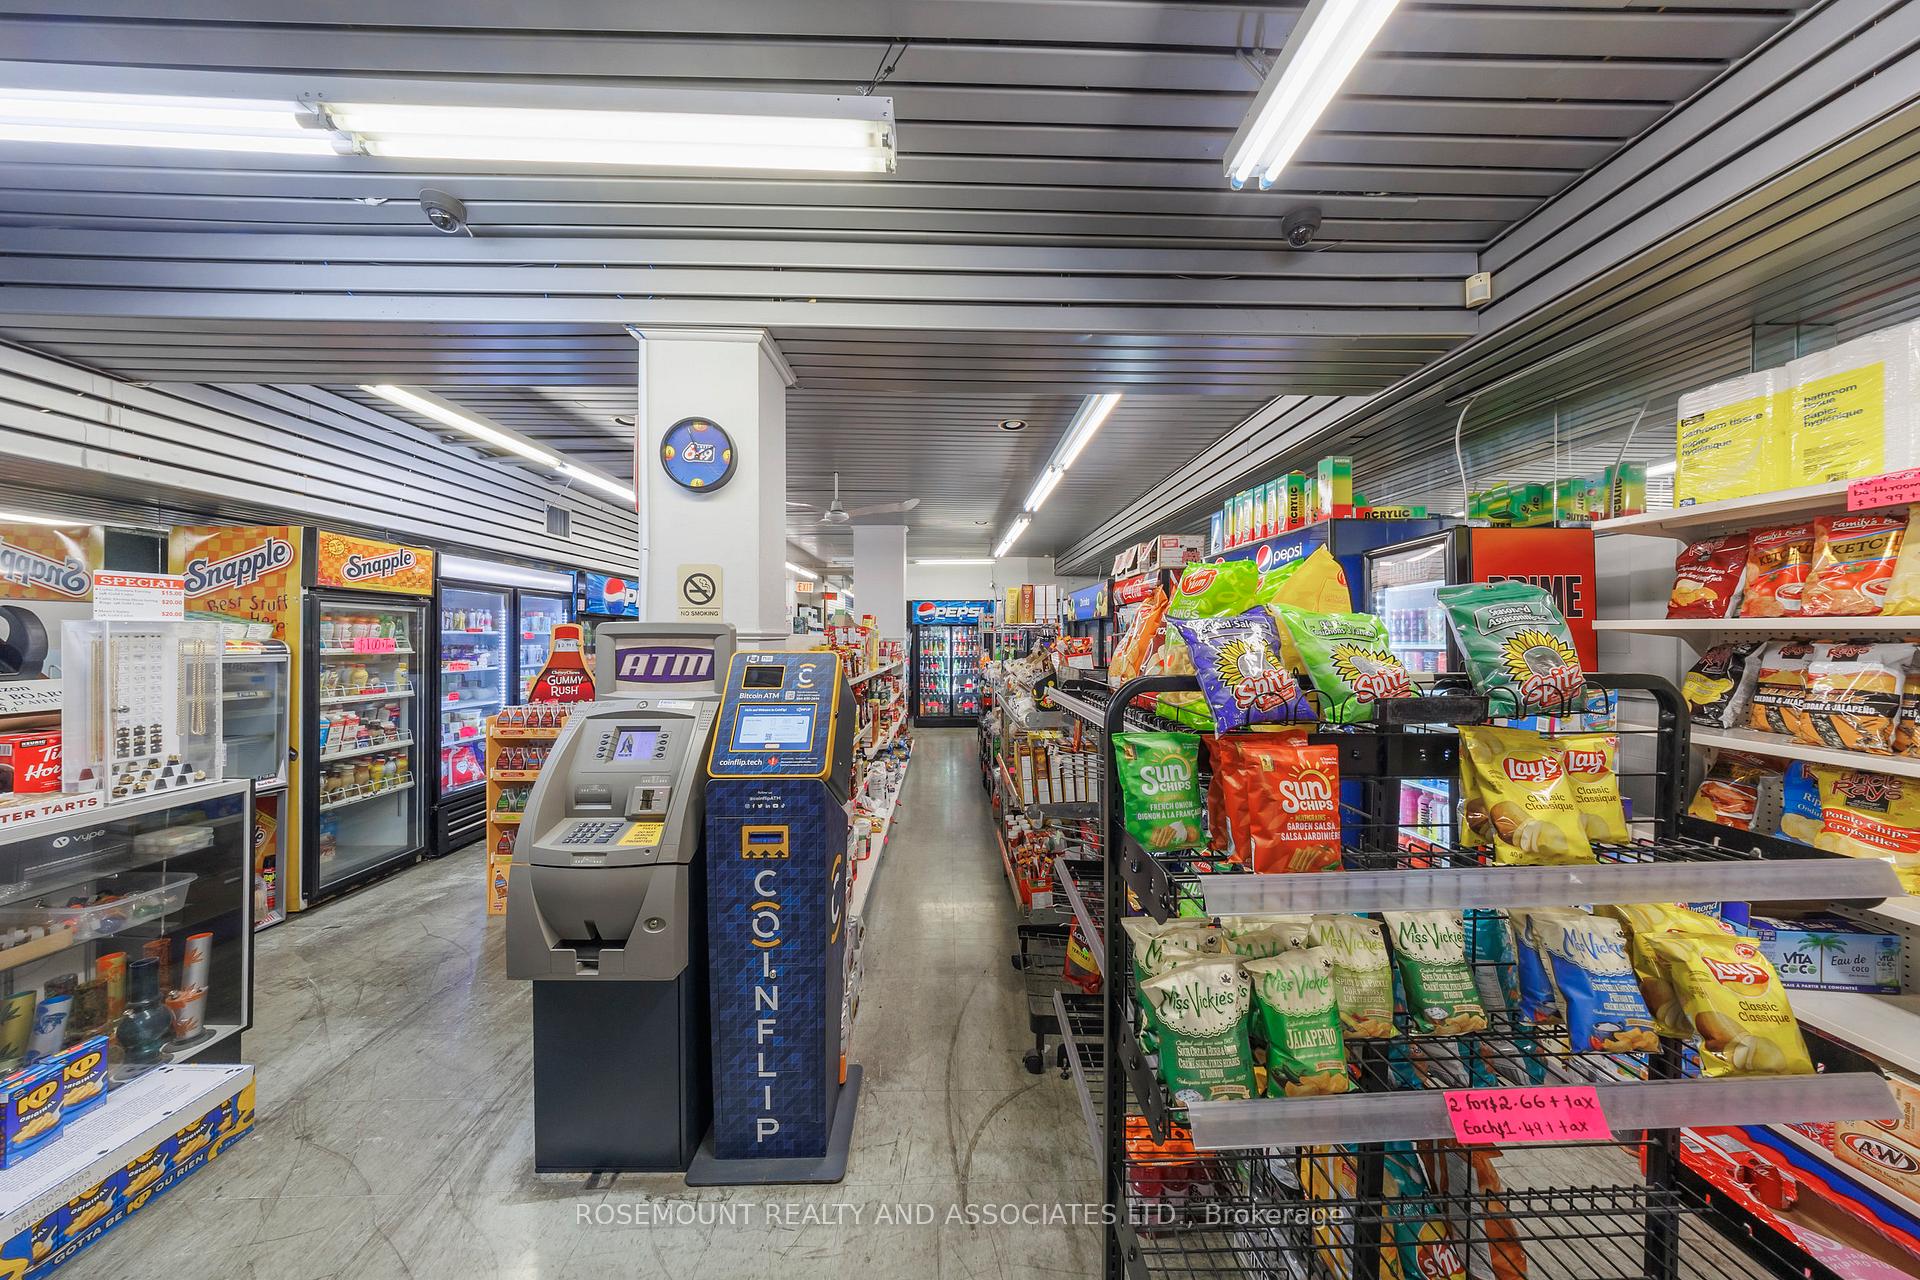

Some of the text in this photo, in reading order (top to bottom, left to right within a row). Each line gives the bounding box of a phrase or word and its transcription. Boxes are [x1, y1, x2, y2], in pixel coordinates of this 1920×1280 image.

[1804, 385, 1857, 402] bathroom
[1364, 510, 1411, 519] ACRYLIC
[1272, 543, 1303, 565] pepsi
[185, 540, 286, 592] Snapple
[346, 549, 412, 578] Snapple
[100, 576, 179, 589] SPECIAL
[798, 582, 813, 592] EXIT
[207, 595, 288, 612] Best Stuff
[1173, 608, 1200, 618] RINGS
[619, 653, 713, 676] ATM
[547, 675, 583, 686] GUMMY
[1238, 668, 1295, 706] Spitz
[1355, 665, 1409, 702] Spitz
[1522, 666, 1583, 706] Spitz
[551, 686, 580, 697] RUSH
[719, 757, 763, 767] coinflip.tech
[1509, 758, 1557, 782] Lay's
[1140, 764, 1191, 795] Sun
[1160, 781, 1191, 792] CHIPS
[1279, 779, 1332, 813] Sun
[1577, 786, 1609, 794] Classic
[42, 798, 97, 815] TARTS
[1300, 800, 1334, 811] CHIPS
[1525, 801, 1574, 811] Classique
[1576, 795, 1617, 804] Classique
[1287, 822, 1335, 831] GARDEN SALSA
[1825, 810, 1909, 839] Potato Chips
[1281, 832, 1302, 841] SALSA
[1400, 921, 1428, 950] Miss
[1783, 951, 1813, 964] VITA
[1831, 954, 1866, 966] Eau de
[1780, 964, 1817, 975] COCO
[1852, 965, 1870, 973] coco
[1264, 970, 1293, 999] Miss
[752, 869, 779, 1142] COINFLIP
[1161, 981, 1234, 1019] Miss Vickie's
[1738, 1001, 1779, 1012] Classic
[1738, 1010, 1791, 1025] Classique
[1287, 1024, 1337, 1049] JALAPEÑO
[64, 1053, 101, 1081] KD
[16, 1081, 58, 1116] KD
[1450, 1100, 1462, 1112] 2
[1564, 1094, 1595, 1109] tax
[19, 1100, 56, 1123] ORIGINAL
[178, 1122, 208, 1145] ORIGINAL
[1558, 1120, 1588, 1132] tax
[1859, 1141, 1903, 1166] A&W
[128, 1153, 162, 1177] ORIGINAL
[54, 1155, 205, 1265] GOTTA BE KD OU RIEN
[71, 1187, 109, 1215] ORIGINAL
